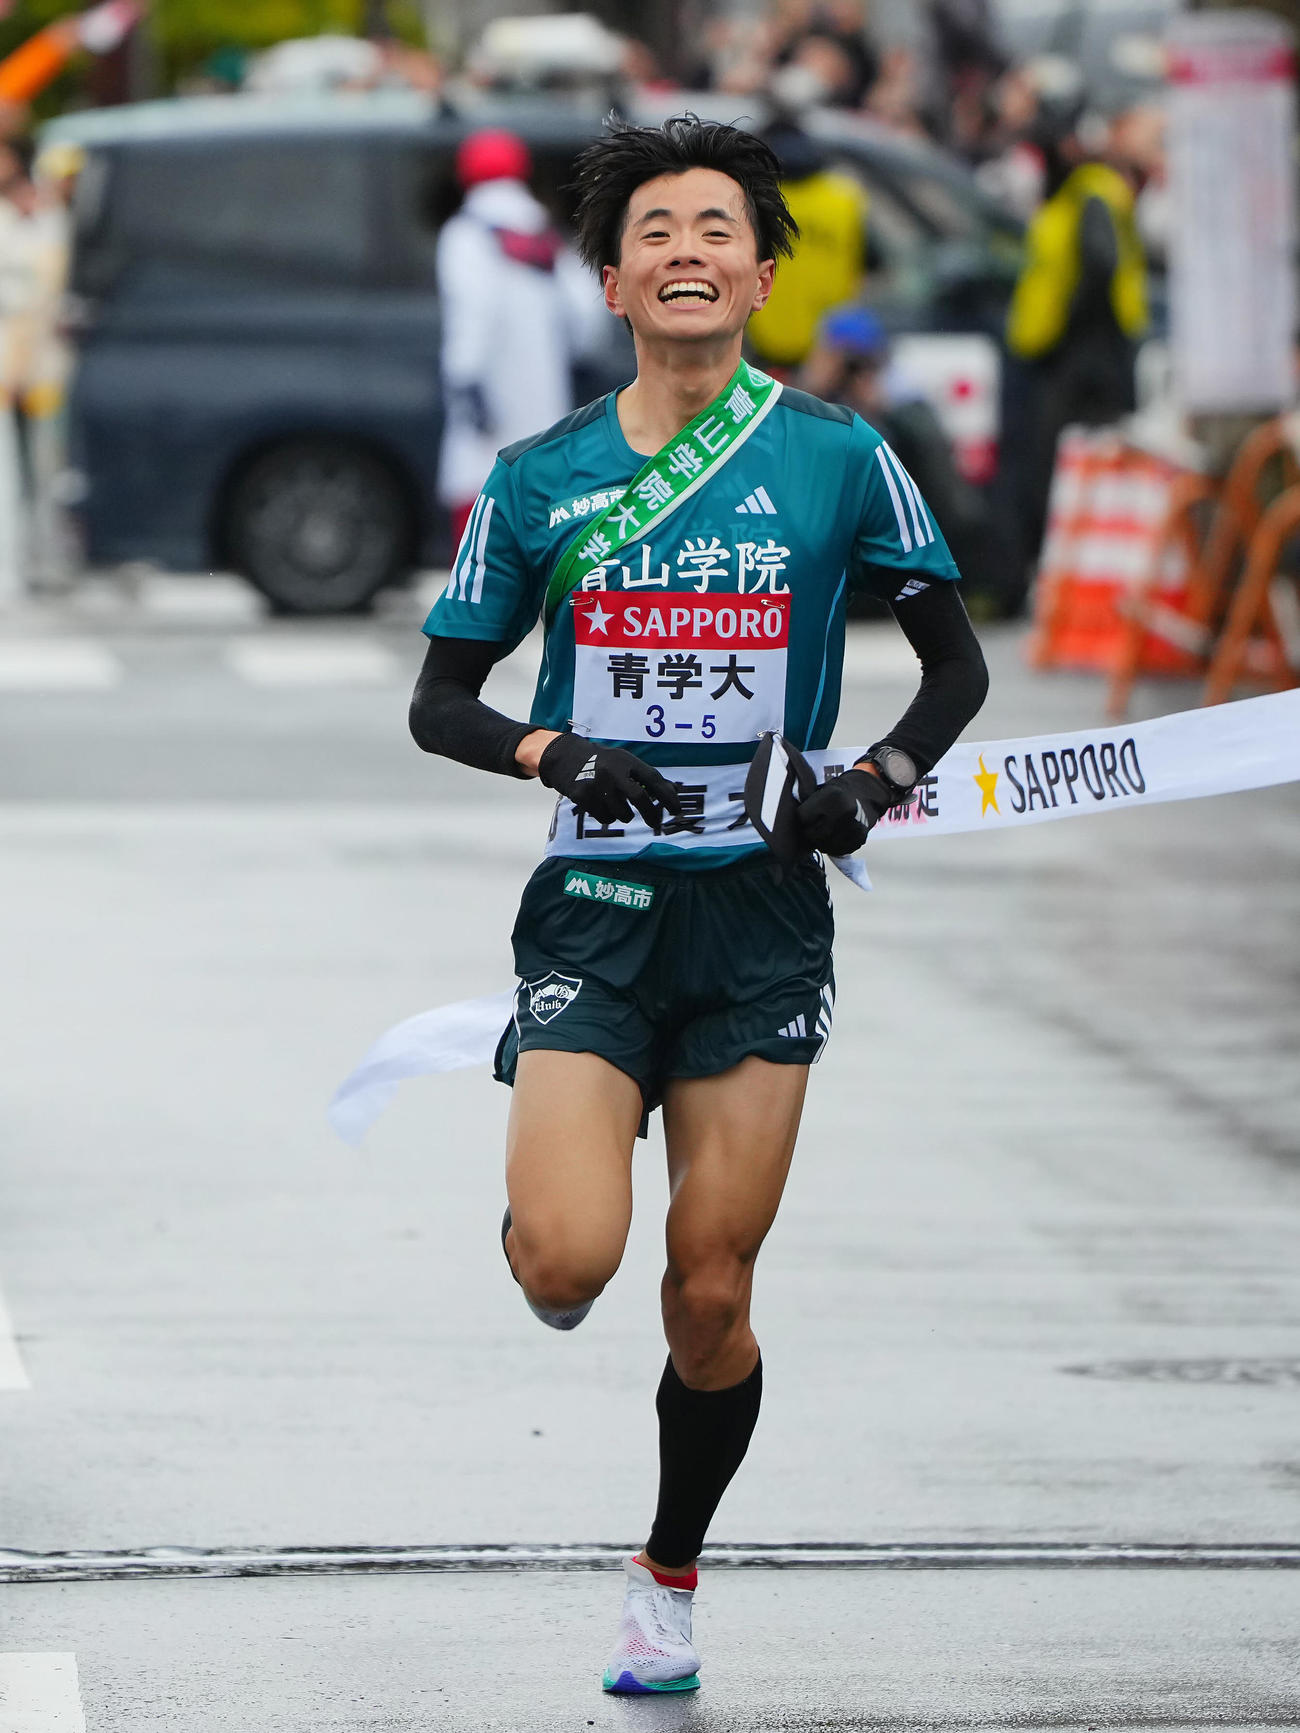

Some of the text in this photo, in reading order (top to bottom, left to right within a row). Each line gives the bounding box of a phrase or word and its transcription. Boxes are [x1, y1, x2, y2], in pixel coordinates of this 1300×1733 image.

[622, 606, 783, 638] SAPPORO
[607, 652, 756, 701] 青学大
[1004, 738, 1146, 814] SAPPORO
[594, 880, 653, 908] 妙高市
